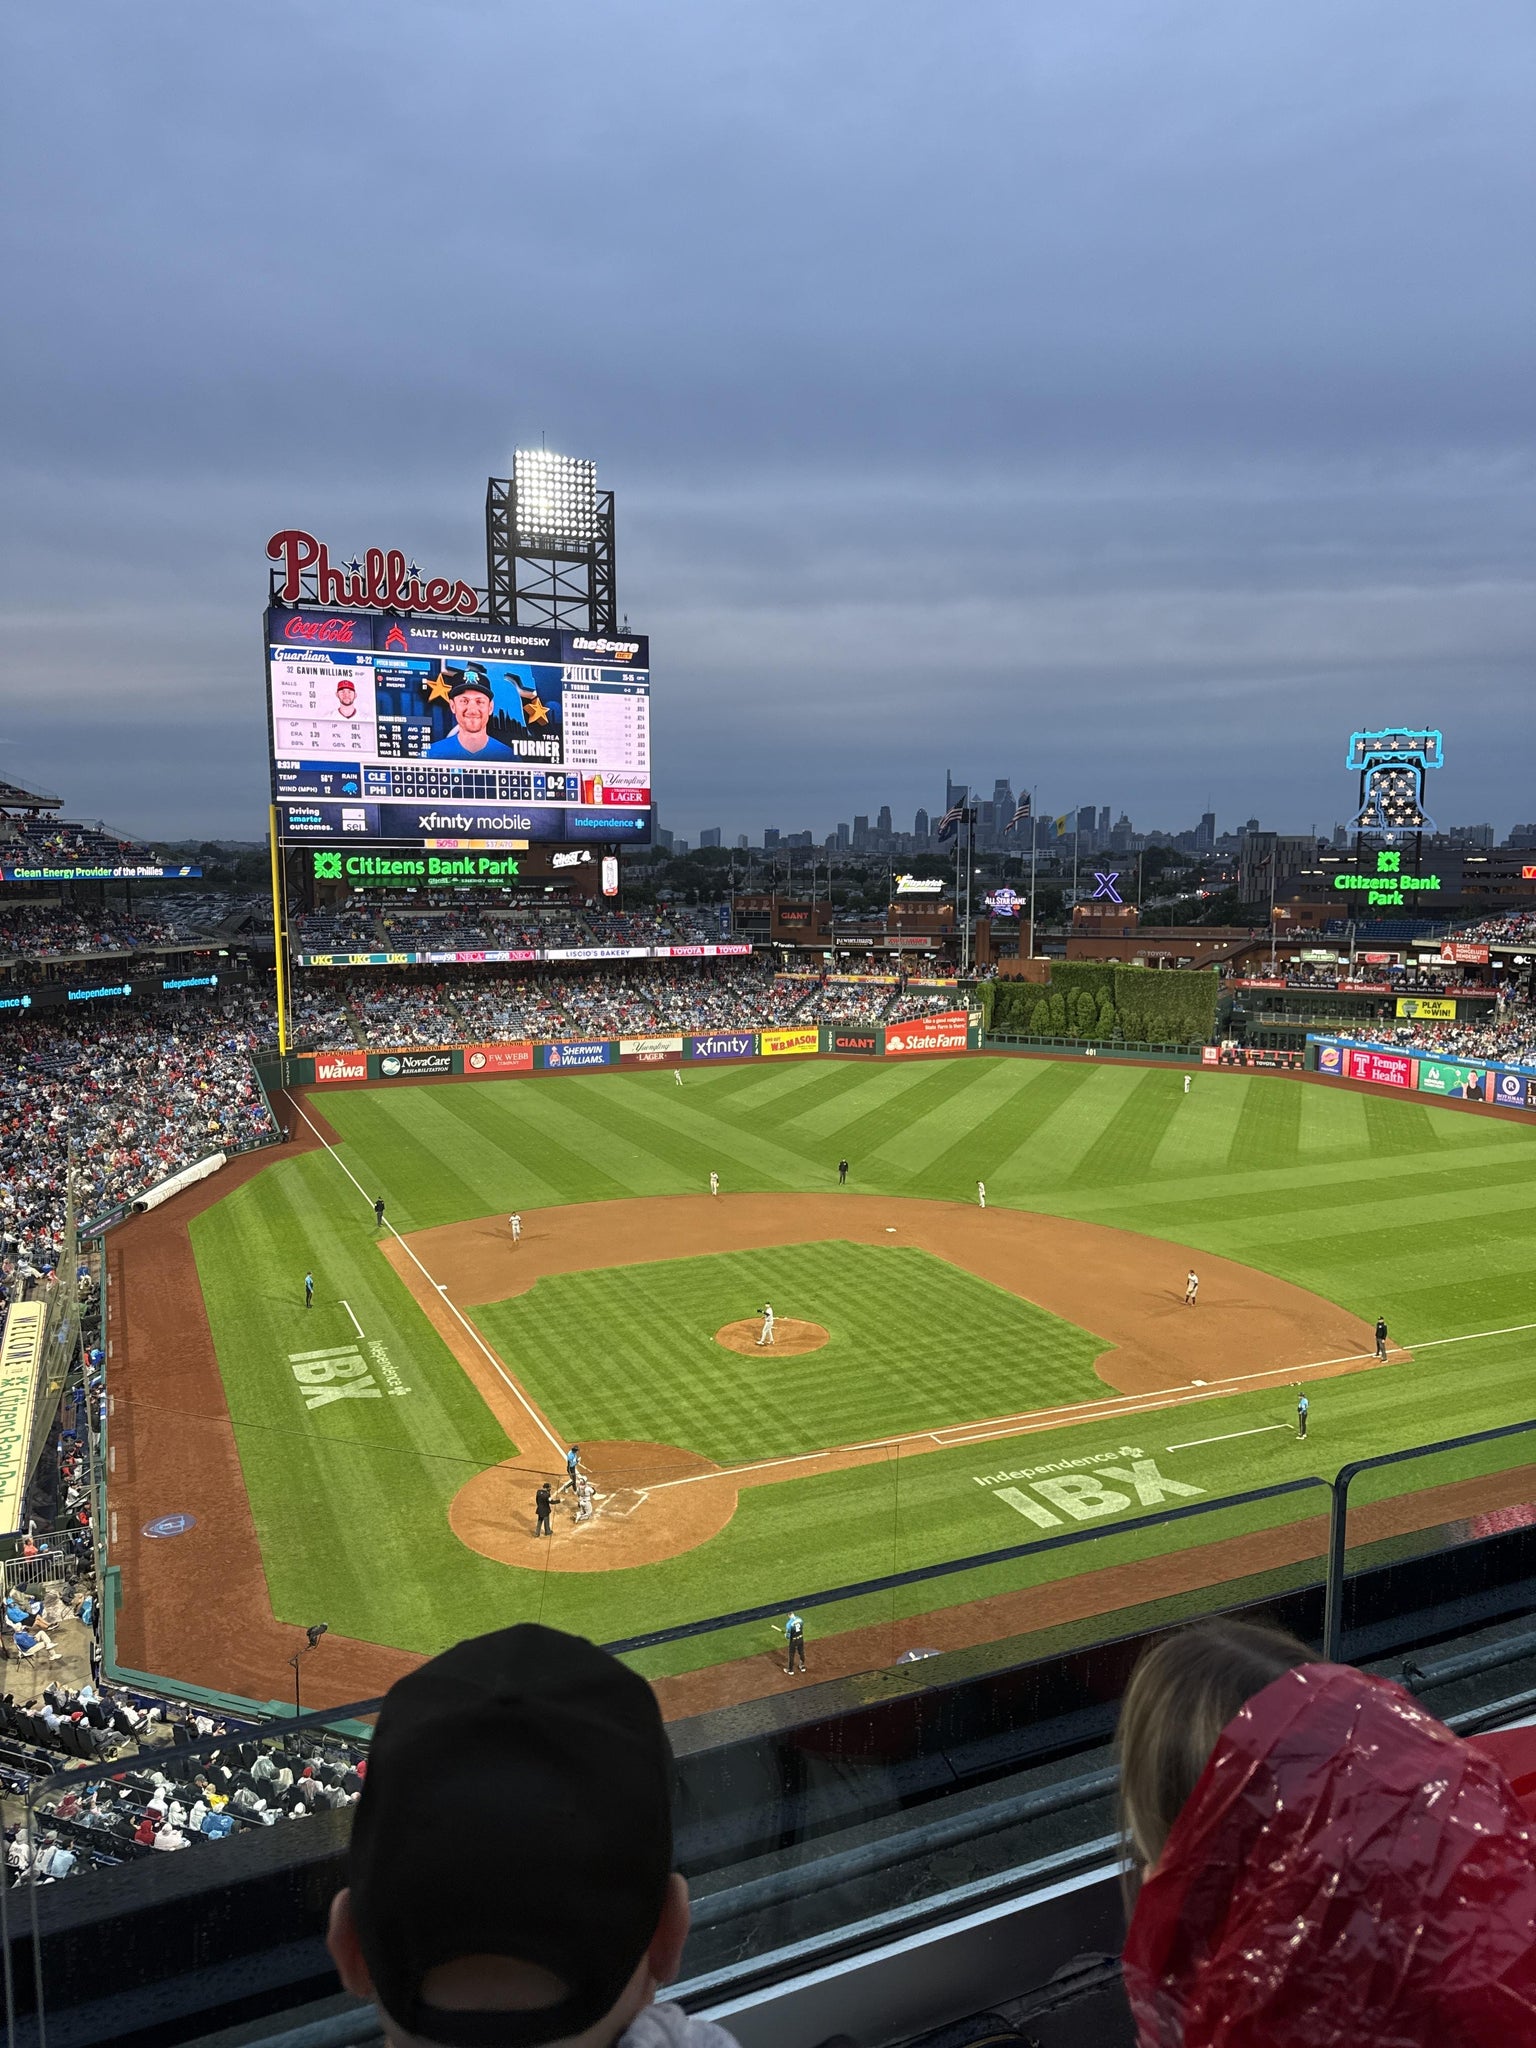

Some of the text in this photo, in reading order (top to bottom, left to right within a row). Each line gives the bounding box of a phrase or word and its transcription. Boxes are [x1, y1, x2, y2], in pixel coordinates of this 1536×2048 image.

[266, 529, 479, 615] Phillies
[284, 616, 356, 643] Coca-Cola
[410, 628, 551, 647] SALTZ MONGELUZZI BENDESKY
[439, 643, 525, 657] INJURY LAWYERS
[572, 637, 640, 653] theScore
[274, 648, 334, 665] Guardians
[287, 665, 353, 678] 32 GAVIN WILLIAMS
[511, 739, 560, 757] TURNER
[368, 772, 386, 782] CLE
[512, 778, 518, 786] 2
[547, 775, 565, 789] 0-2
[570, 779, 575, 787] 2
[605, 772, 648, 786] Yuengling
[324, 786, 331, 794] 12
[369, 786, 387, 795] PHI
[610, 793, 643, 802] LAGER
[289, 807, 320, 817] Driving
[289, 823, 333, 831] outcomes.
[419, 812, 531, 831] xfinity mobile
[575, 817, 634, 828] Independence
[346, 856, 519, 875] Citizens Bank Park
[14, 866, 164, 879] Clean Energy Provider of the Phillies
[1334, 874, 1441, 890] Citizens Bank
[985, 896, 996, 905] ALL
[1011, 897, 1027, 905] GAME
[1368, 890, 1404, 905] Park
[601, 949, 631, 957] BAKERY
[719, 946, 747, 954] TOYOTA
[310, 955, 333, 965] UKG
[348, 954, 371, 964] UKG
[386, 953, 408, 964] UKG
[163, 976, 210, 989] Independence
[1353, 984, 1386, 992] Budweiser
[68, 986, 121, 1000] Independence
[1421, 1001, 1443, 1009] PLAY
[1431, 1009, 1451, 1017] WIN!
[631, 1041, 671, 1052] Yuengling
[696, 1037, 749, 1056] xfinity
[836, 1037, 875, 1049] GIANT
[906, 1034, 966, 1050] StateFarm
[505, 1052, 529, 1060] WEBB
[562, 1045, 603, 1056] SHERWIN
[639, 1053, 665, 1061] LAGER
[1085, 1048, 1097, 1056] 401
[401, 1055, 451, 1068] NovaCare
[561, 1055, 605, 1066] WILLIAMS.
[1372, 1056, 1408, 1072] Temple
[318, 1065, 364, 1079] Wawa
[402, 1066, 449, 1074] REHABILITATION
[1372, 1069, 1404, 1085] Health
[1507, 1080, 1516, 1091] R
[1497, 1093, 1524, 1102] ROTHMAN
[5, 1316, 38, 1366] WELCOME
[368, 1340, 403, 1386] Independence
[288, 1345, 382, 1410] IBX
[973, 1450, 1119, 1487] Independence
[992, 1459, 1208, 1528] IBX
